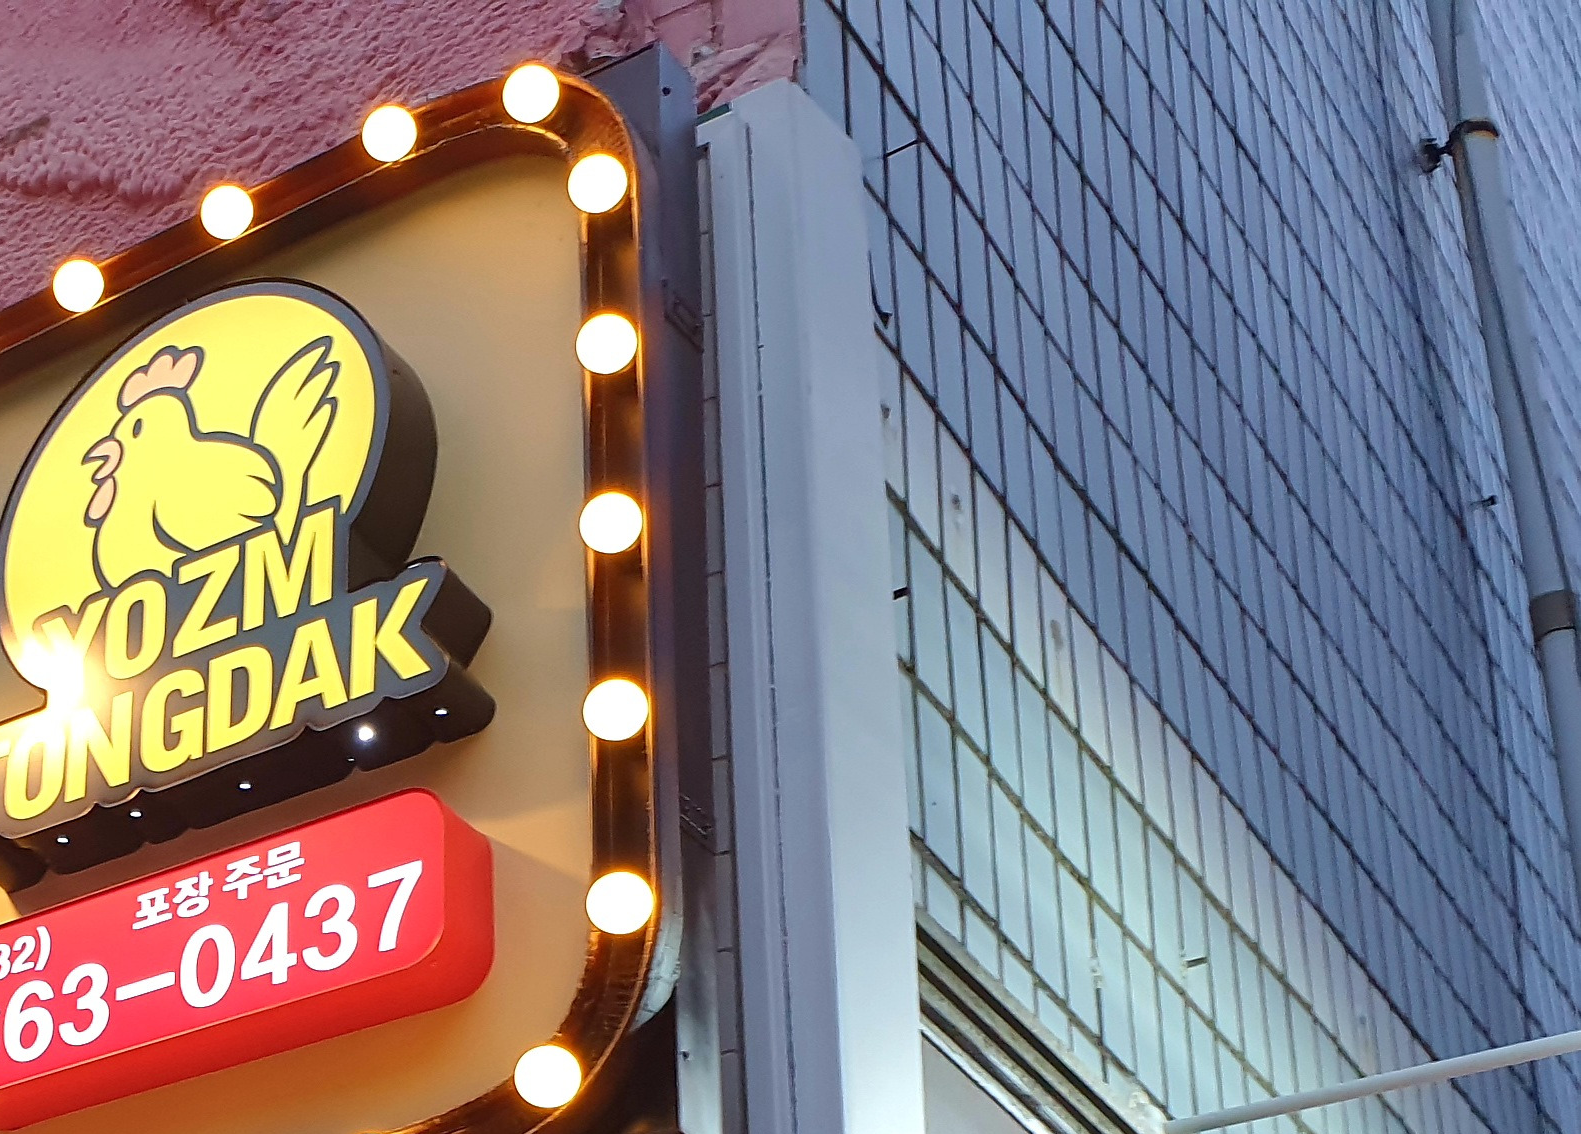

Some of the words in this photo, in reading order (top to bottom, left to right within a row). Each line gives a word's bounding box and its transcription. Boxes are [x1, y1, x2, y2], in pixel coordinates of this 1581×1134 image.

[32, 507, 336, 690] YOZM
[132, 871, 213, 930] 포장
[221, 841, 306, 901] 주문
